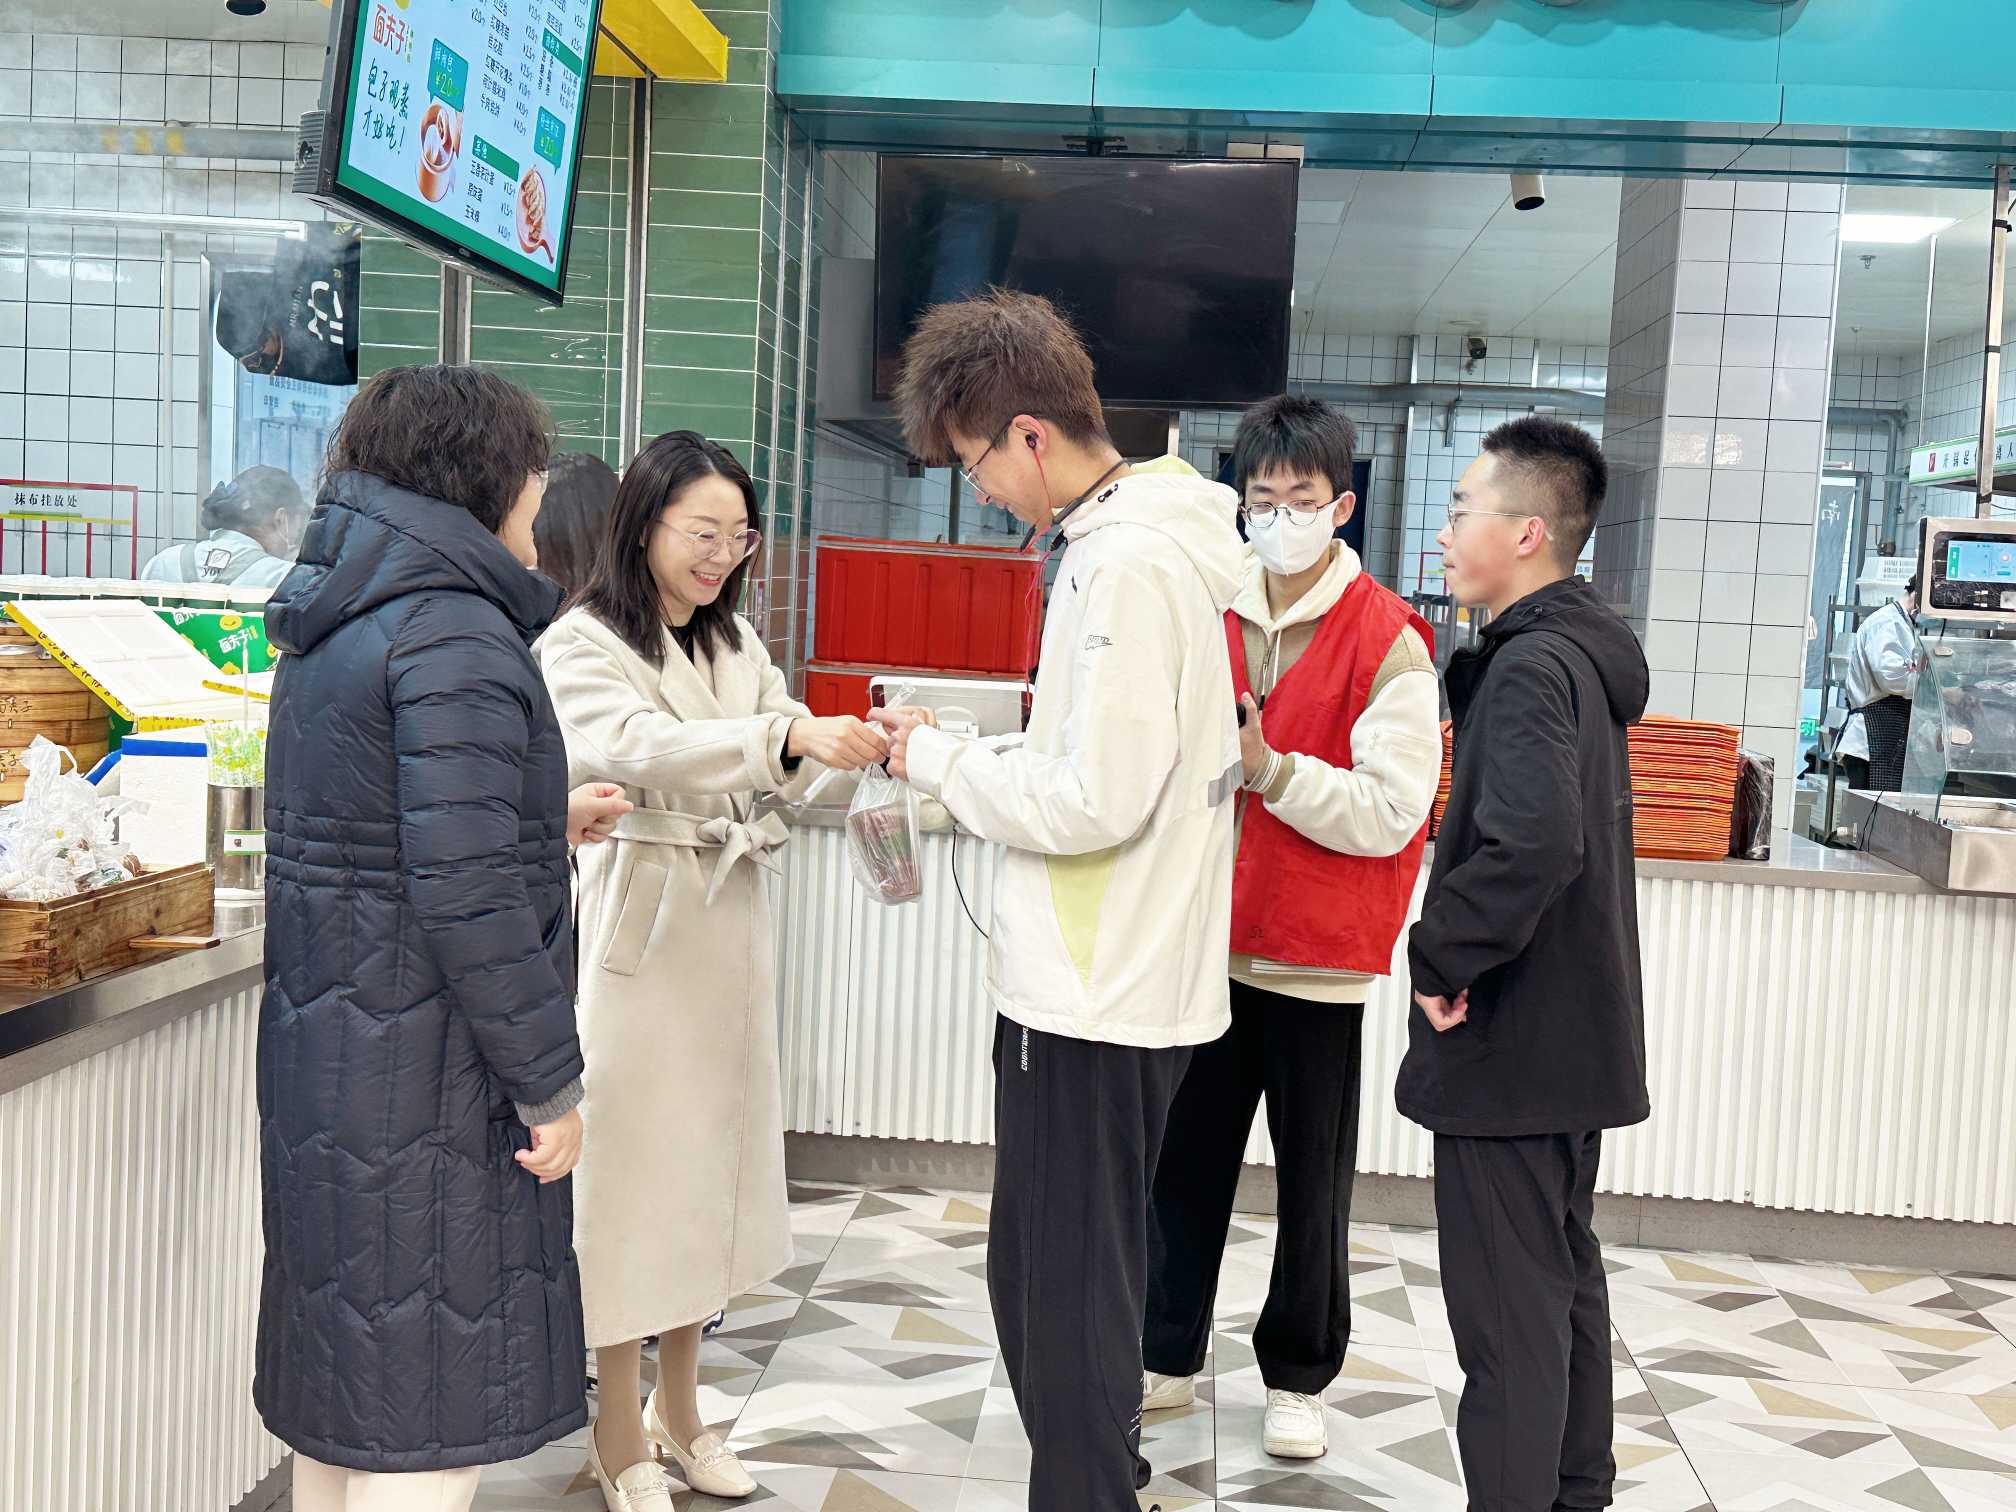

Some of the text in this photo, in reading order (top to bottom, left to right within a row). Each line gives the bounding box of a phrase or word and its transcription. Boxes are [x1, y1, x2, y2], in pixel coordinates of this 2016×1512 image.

[373, 3, 406, 55] 面夫子
[367, 57, 409, 120] 包子现蒸
[14, 492, 79, 508] 抹布挂放处
